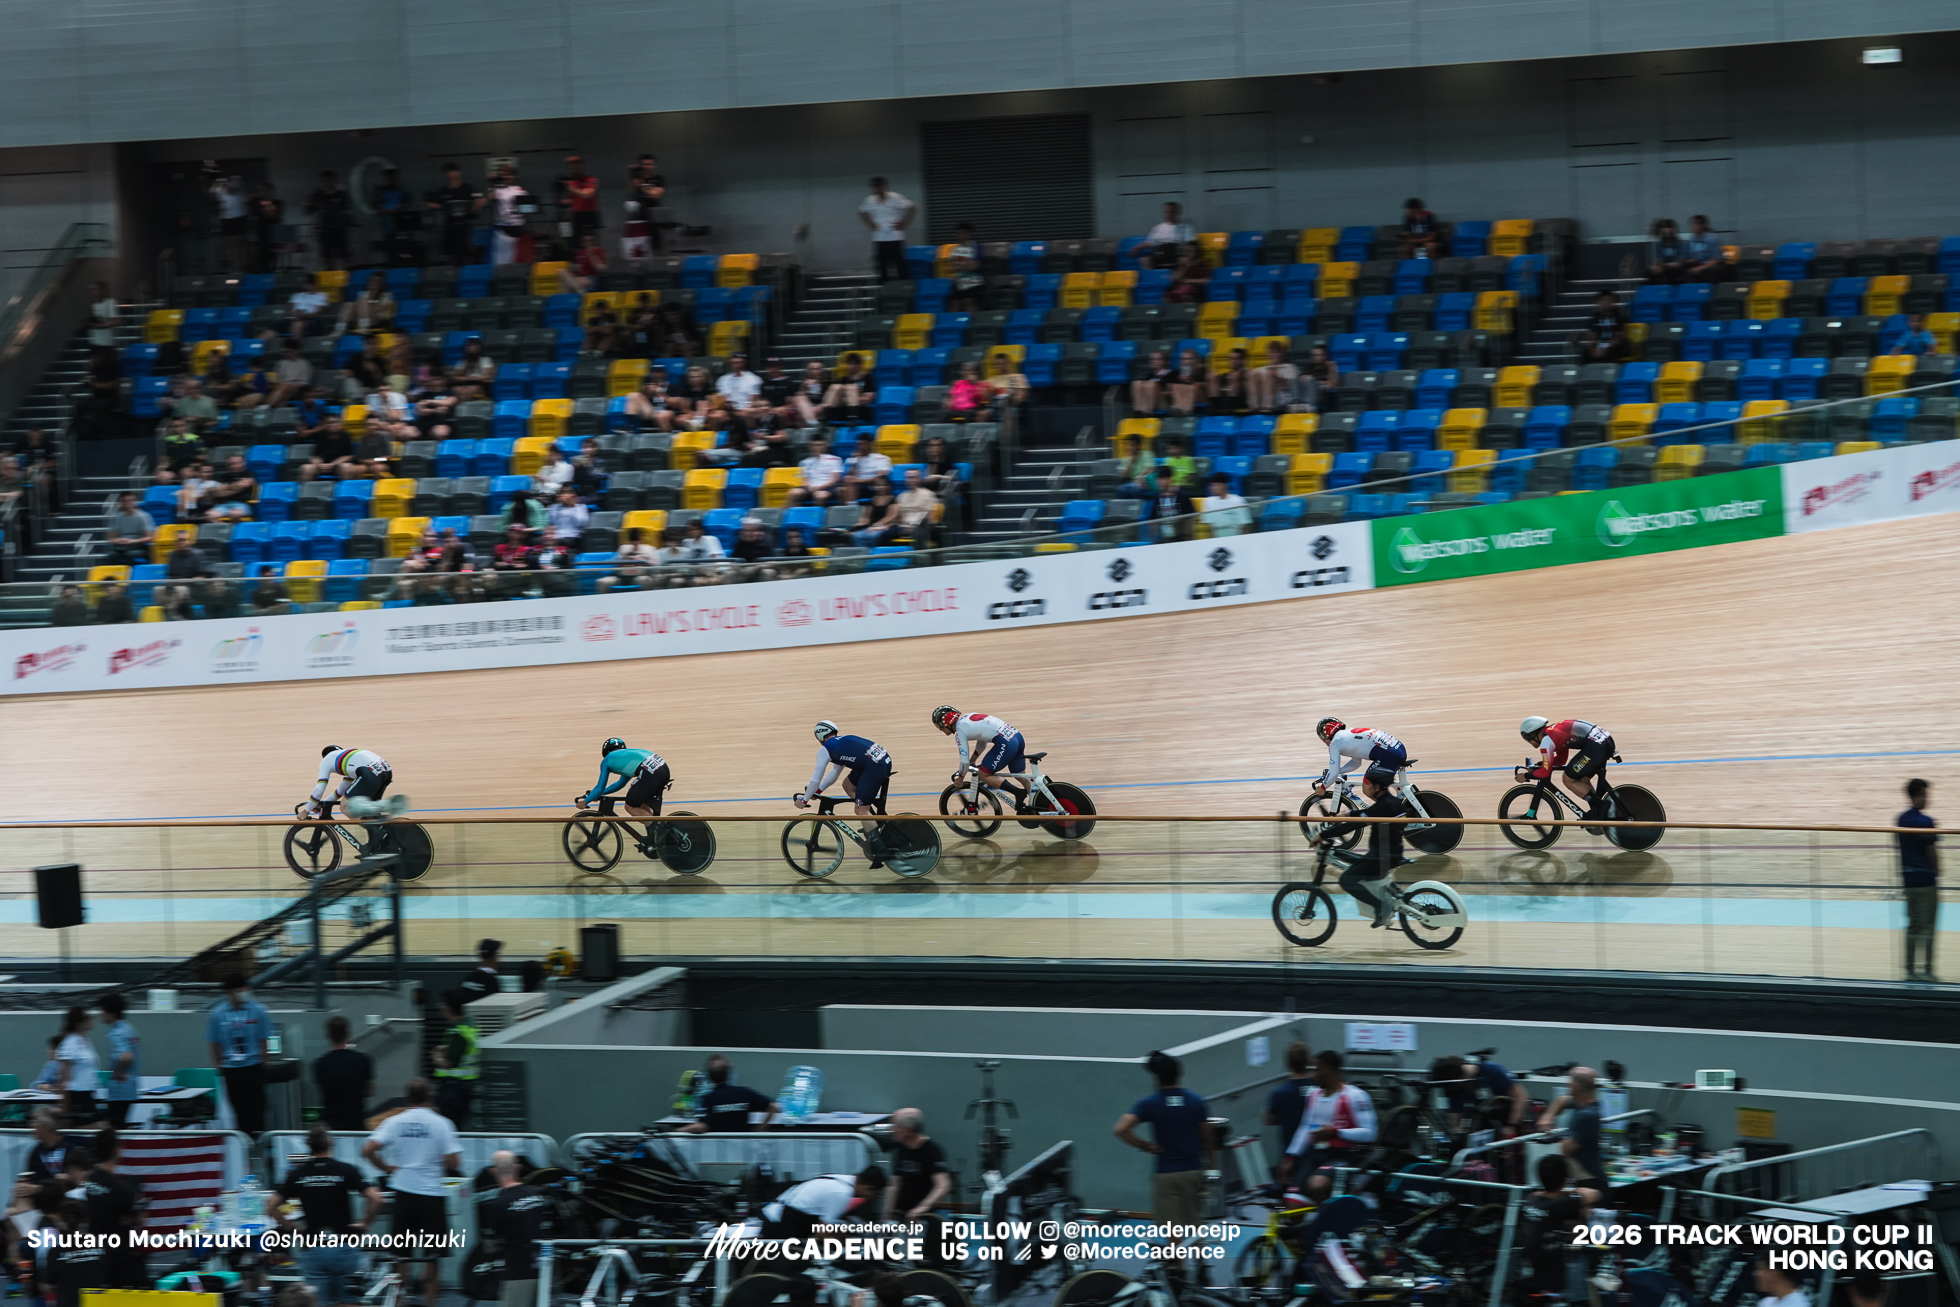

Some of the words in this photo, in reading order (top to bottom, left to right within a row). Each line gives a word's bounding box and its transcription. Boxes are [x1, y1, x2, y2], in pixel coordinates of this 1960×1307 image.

[1699, 500, 1767, 522] water
[1490, 528, 1557, 549] water
[818, 594, 890, 621] LAW'S
[891, 588, 960, 614] CYCLE
[622, 610, 691, 636] LAW'S
[692, 605, 761, 632] CYCLE
[870, 748, 881, 759] 93
[991, 743, 1006, 770] JAPAN
[1573, 755, 1591, 773] CHINA
[1555, 791, 1584, 818] KOGA
